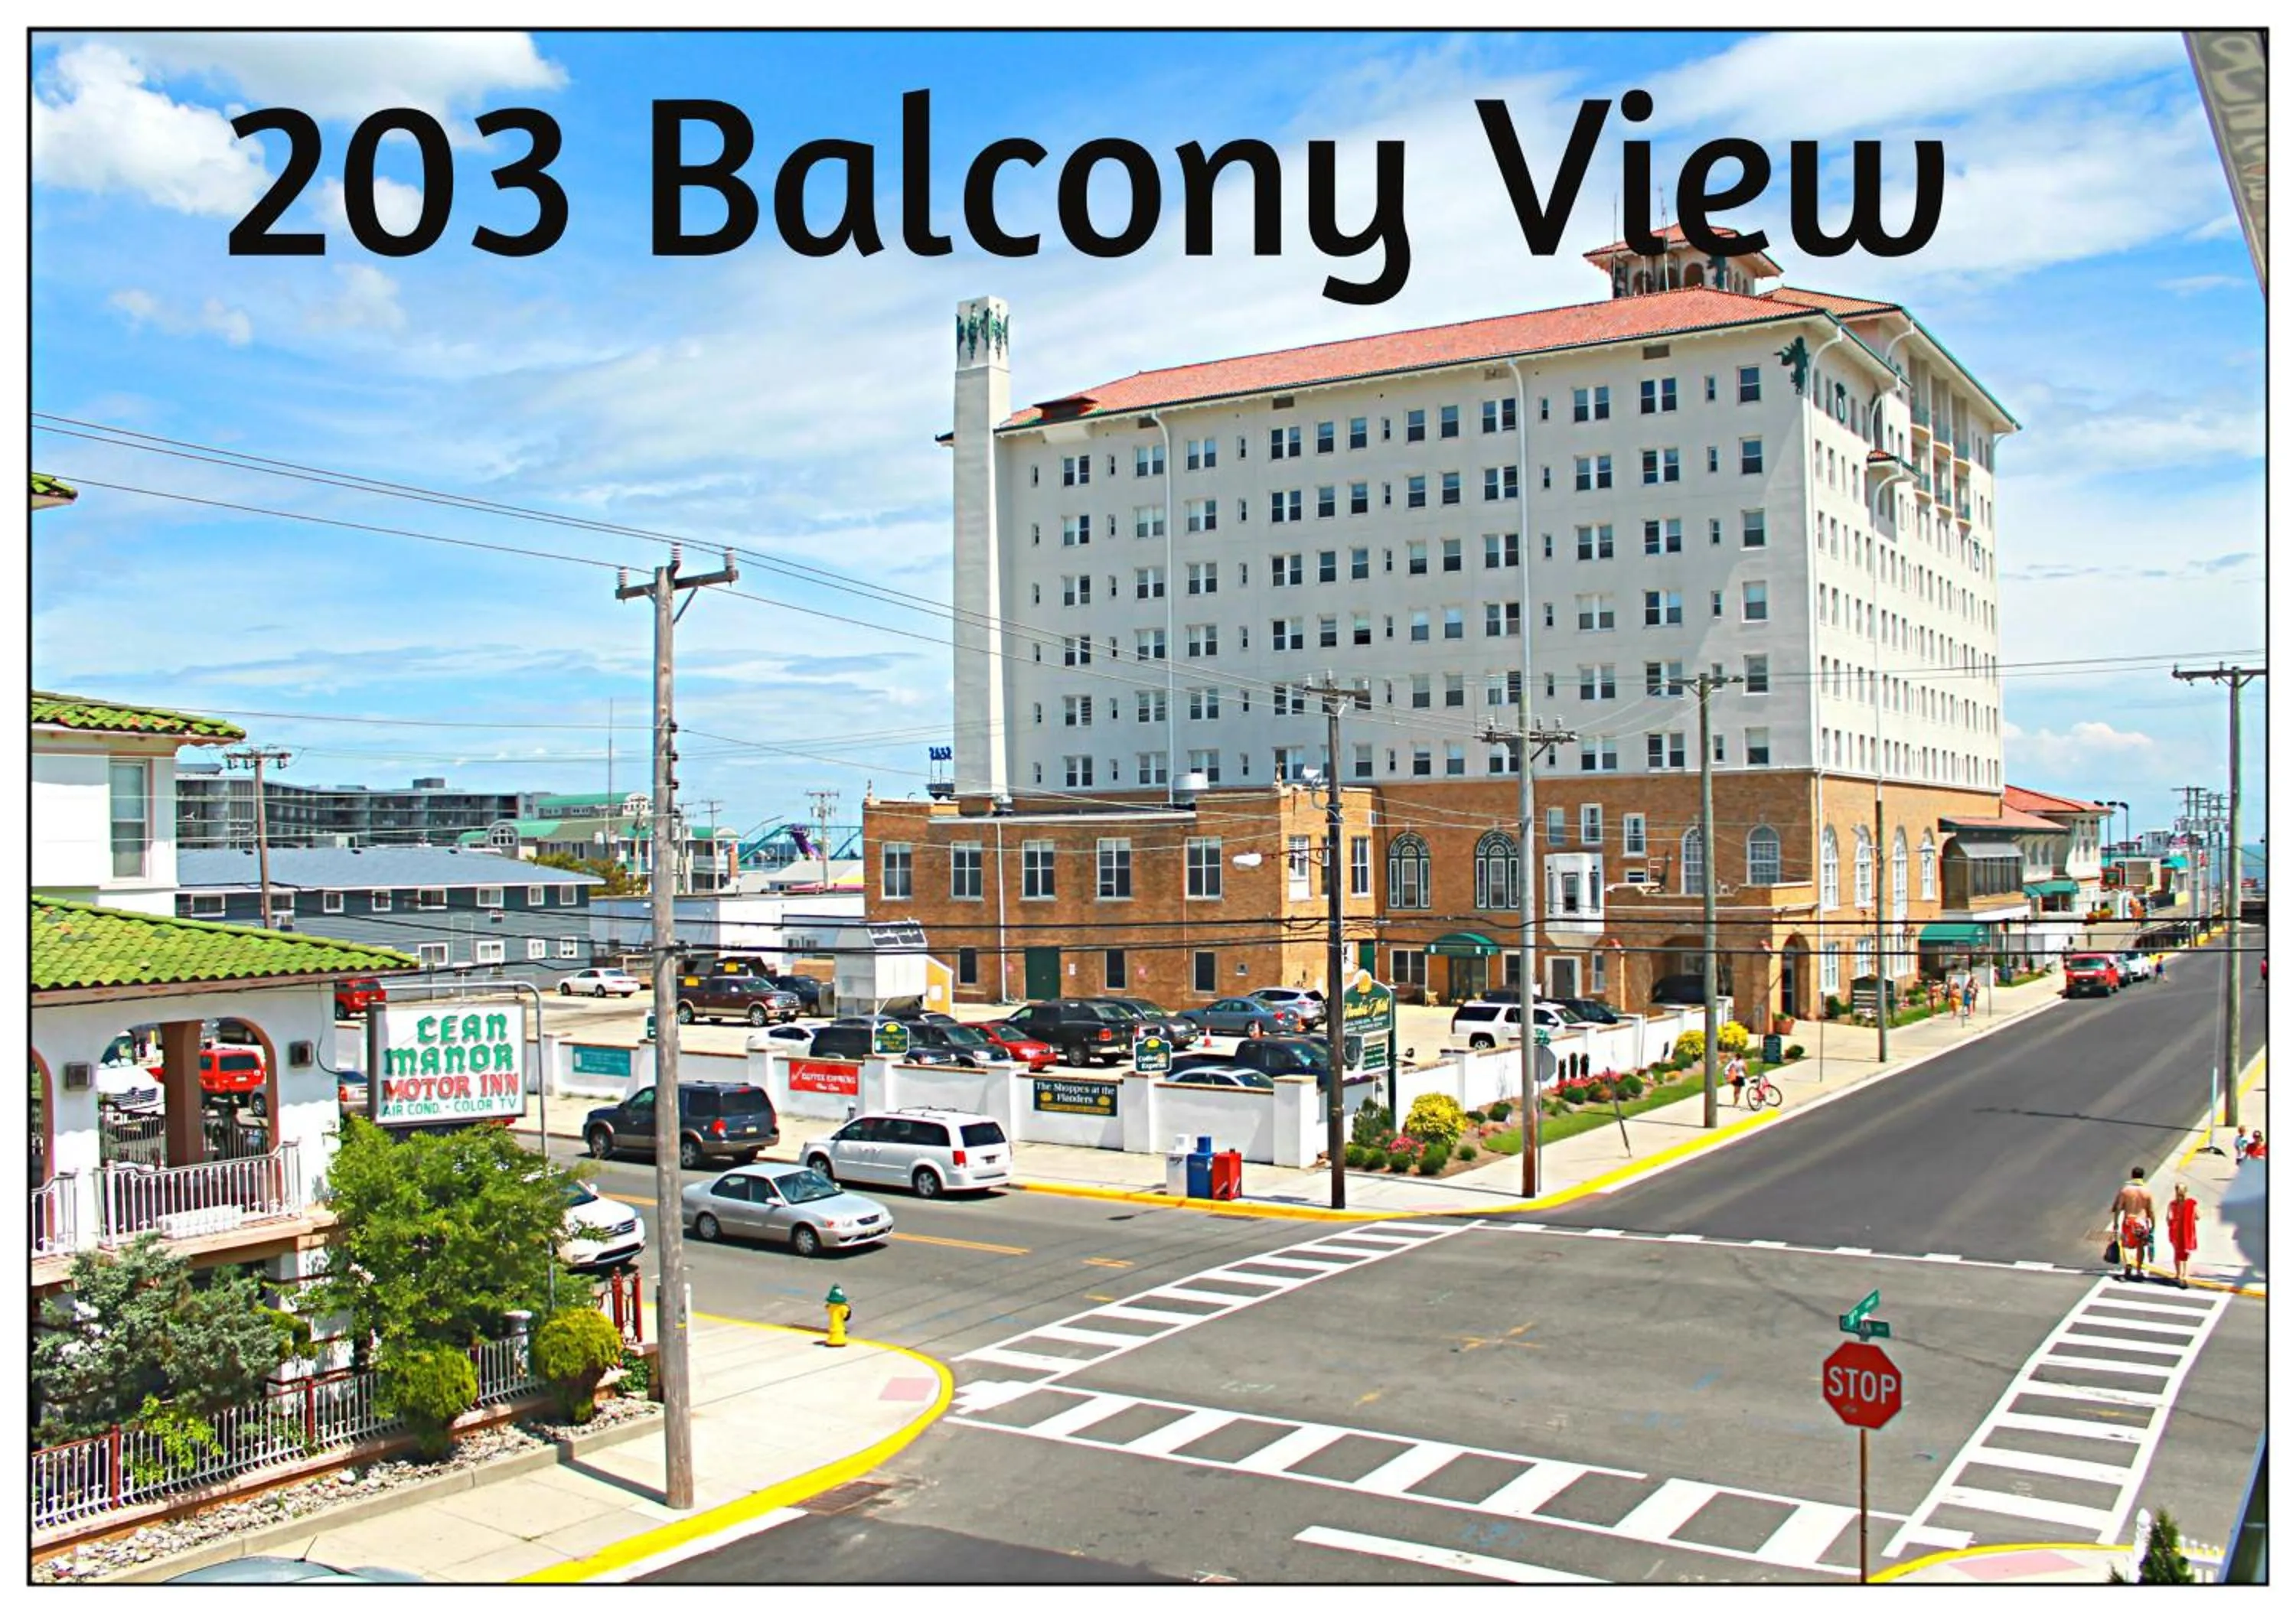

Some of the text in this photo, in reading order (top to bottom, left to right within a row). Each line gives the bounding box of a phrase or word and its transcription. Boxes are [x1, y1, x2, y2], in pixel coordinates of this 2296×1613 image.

[417, 1013, 507, 1044] CEAN
[384, 1043, 514, 1077] MANOR
[382, 1073, 519, 1102] MOTOR INN
[1036, 1081, 1115, 1095] The Shoppes at the
[380, 1103, 403, 1118] AIR
[407, 1102, 442, 1116] COND.
[454, 1099, 493, 1113] COLOR
[499, 1097, 517, 1110] TV
[1827, 1365, 1896, 1404] STOP
